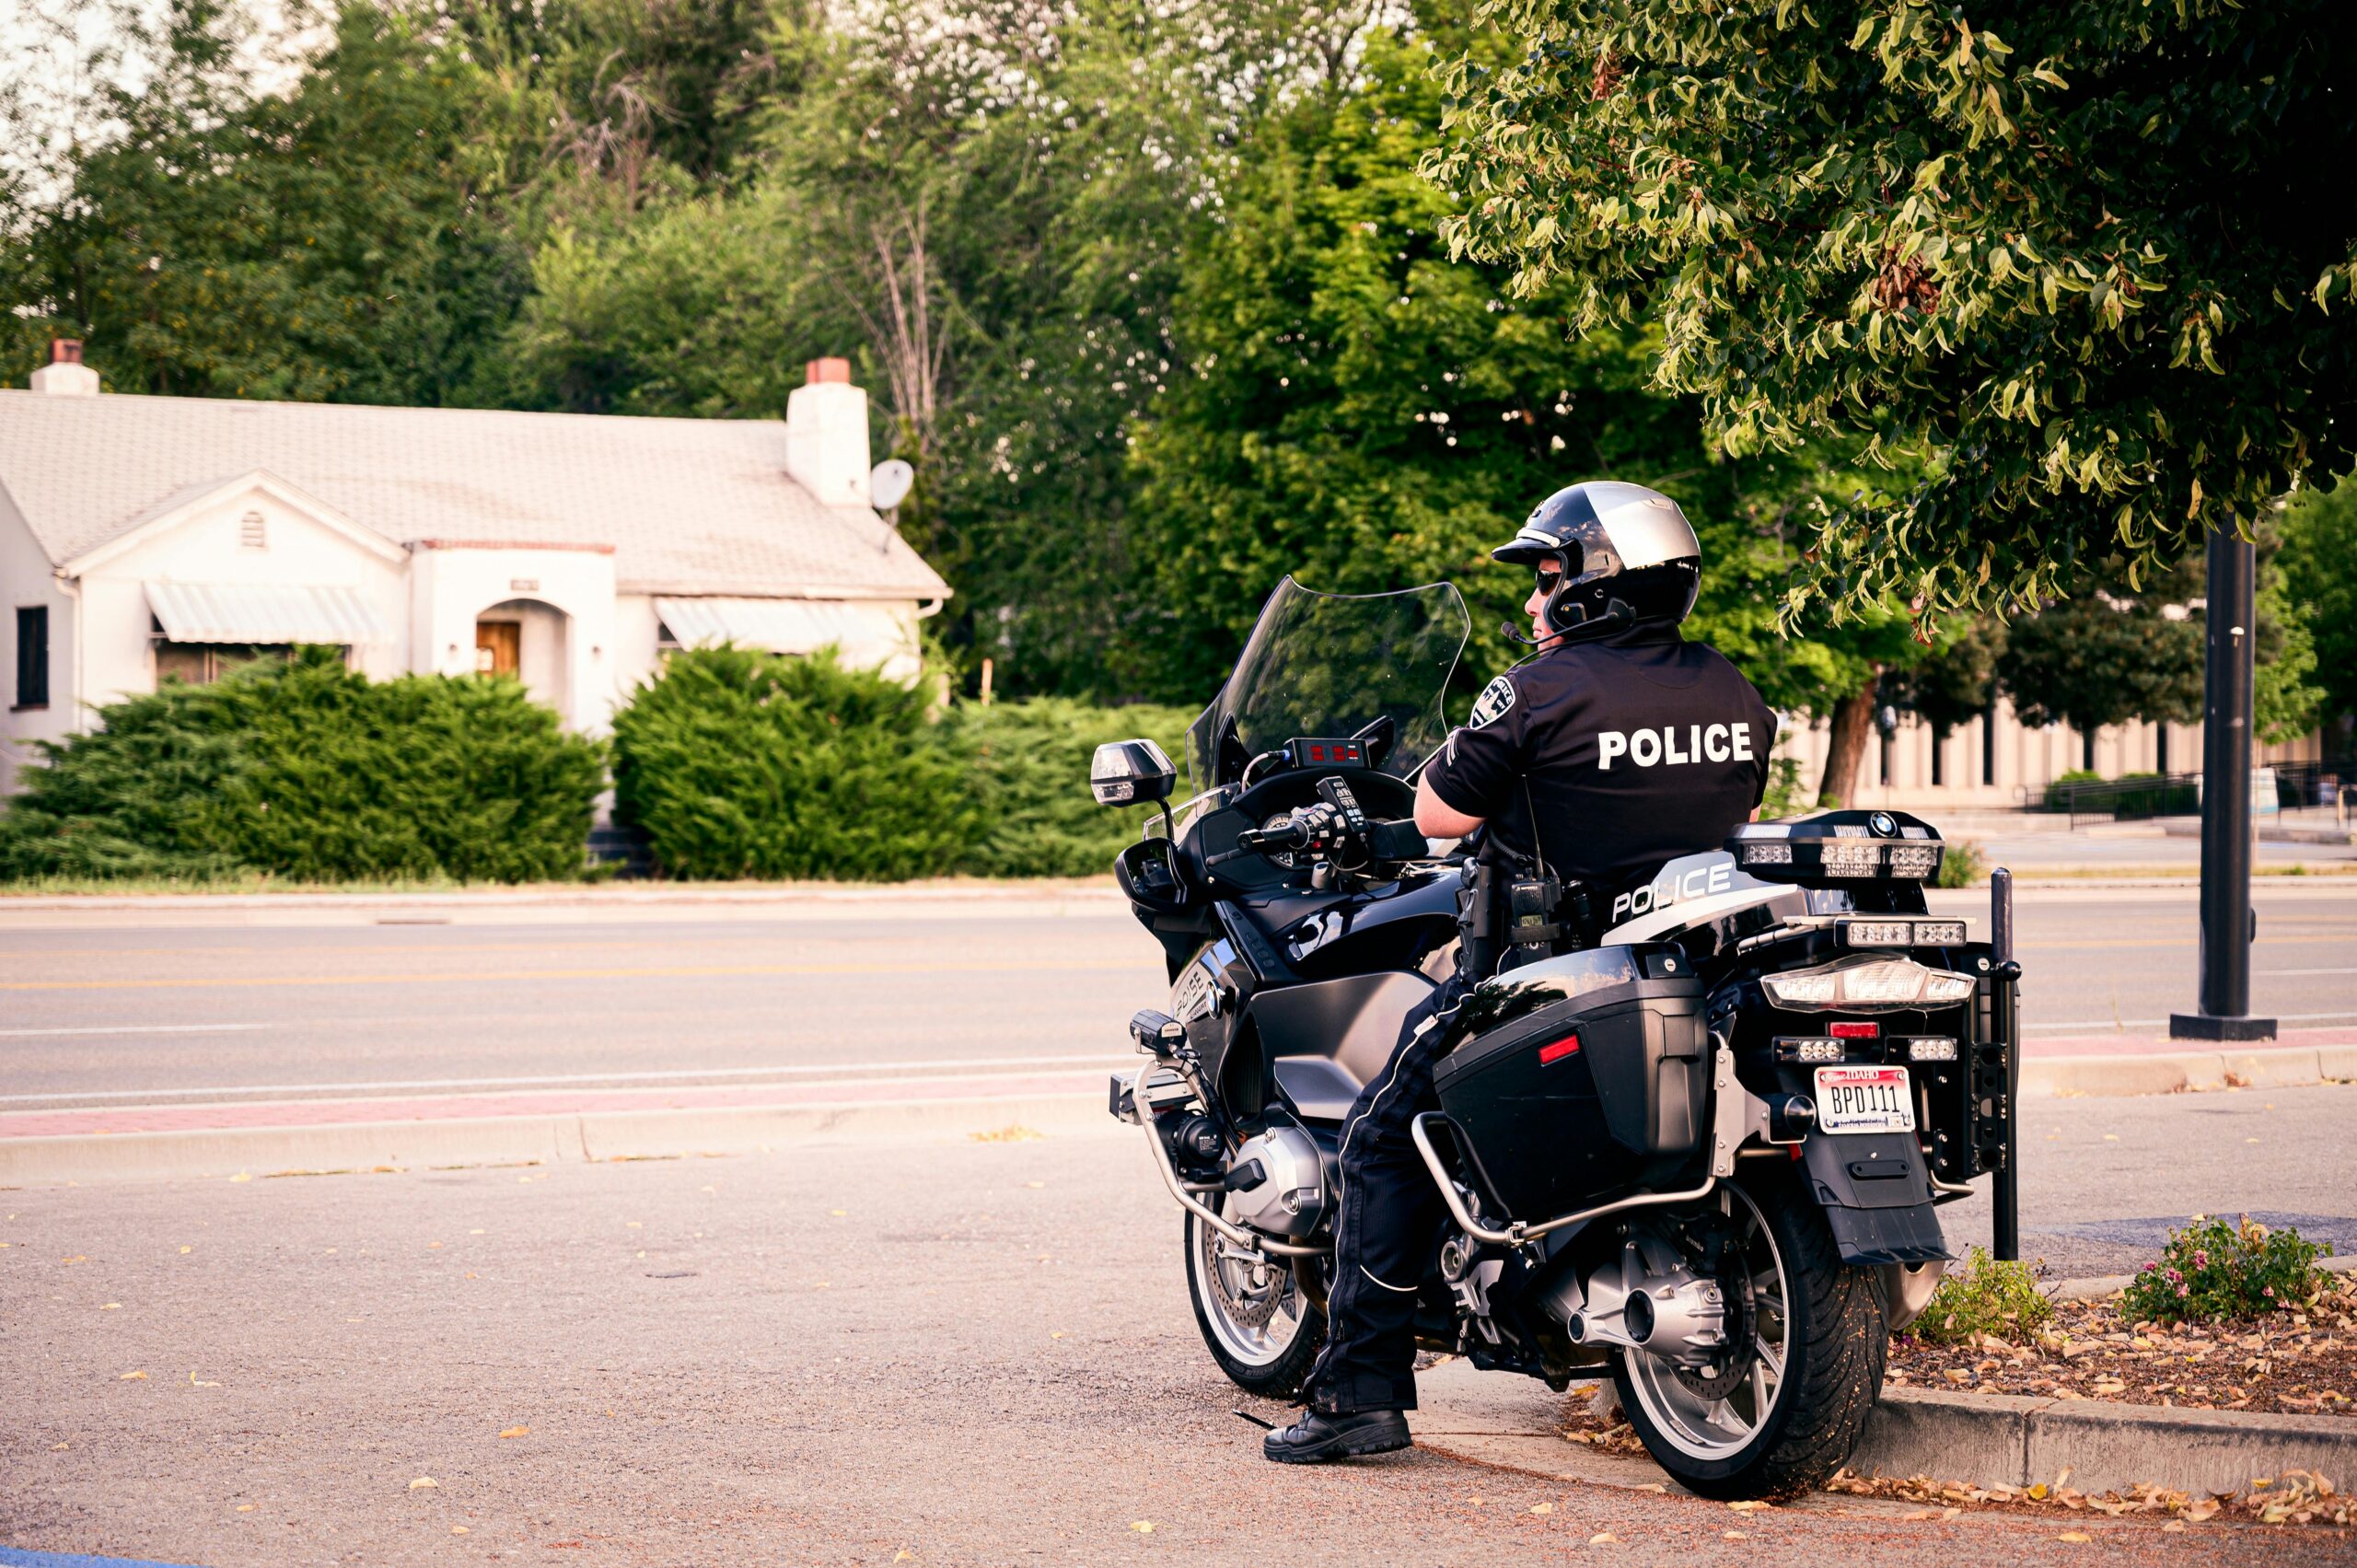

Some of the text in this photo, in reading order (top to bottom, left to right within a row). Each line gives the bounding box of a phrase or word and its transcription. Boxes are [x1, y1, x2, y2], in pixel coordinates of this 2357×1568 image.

[1492, 679, 1513, 704] POLICE
[1598, 723, 1753, 770] POLICE
[1612, 862, 1733, 923] POLICE
[1846, 1070, 1879, 1080] IDAHO
[1831, 1085, 1899, 1114] BPD111
